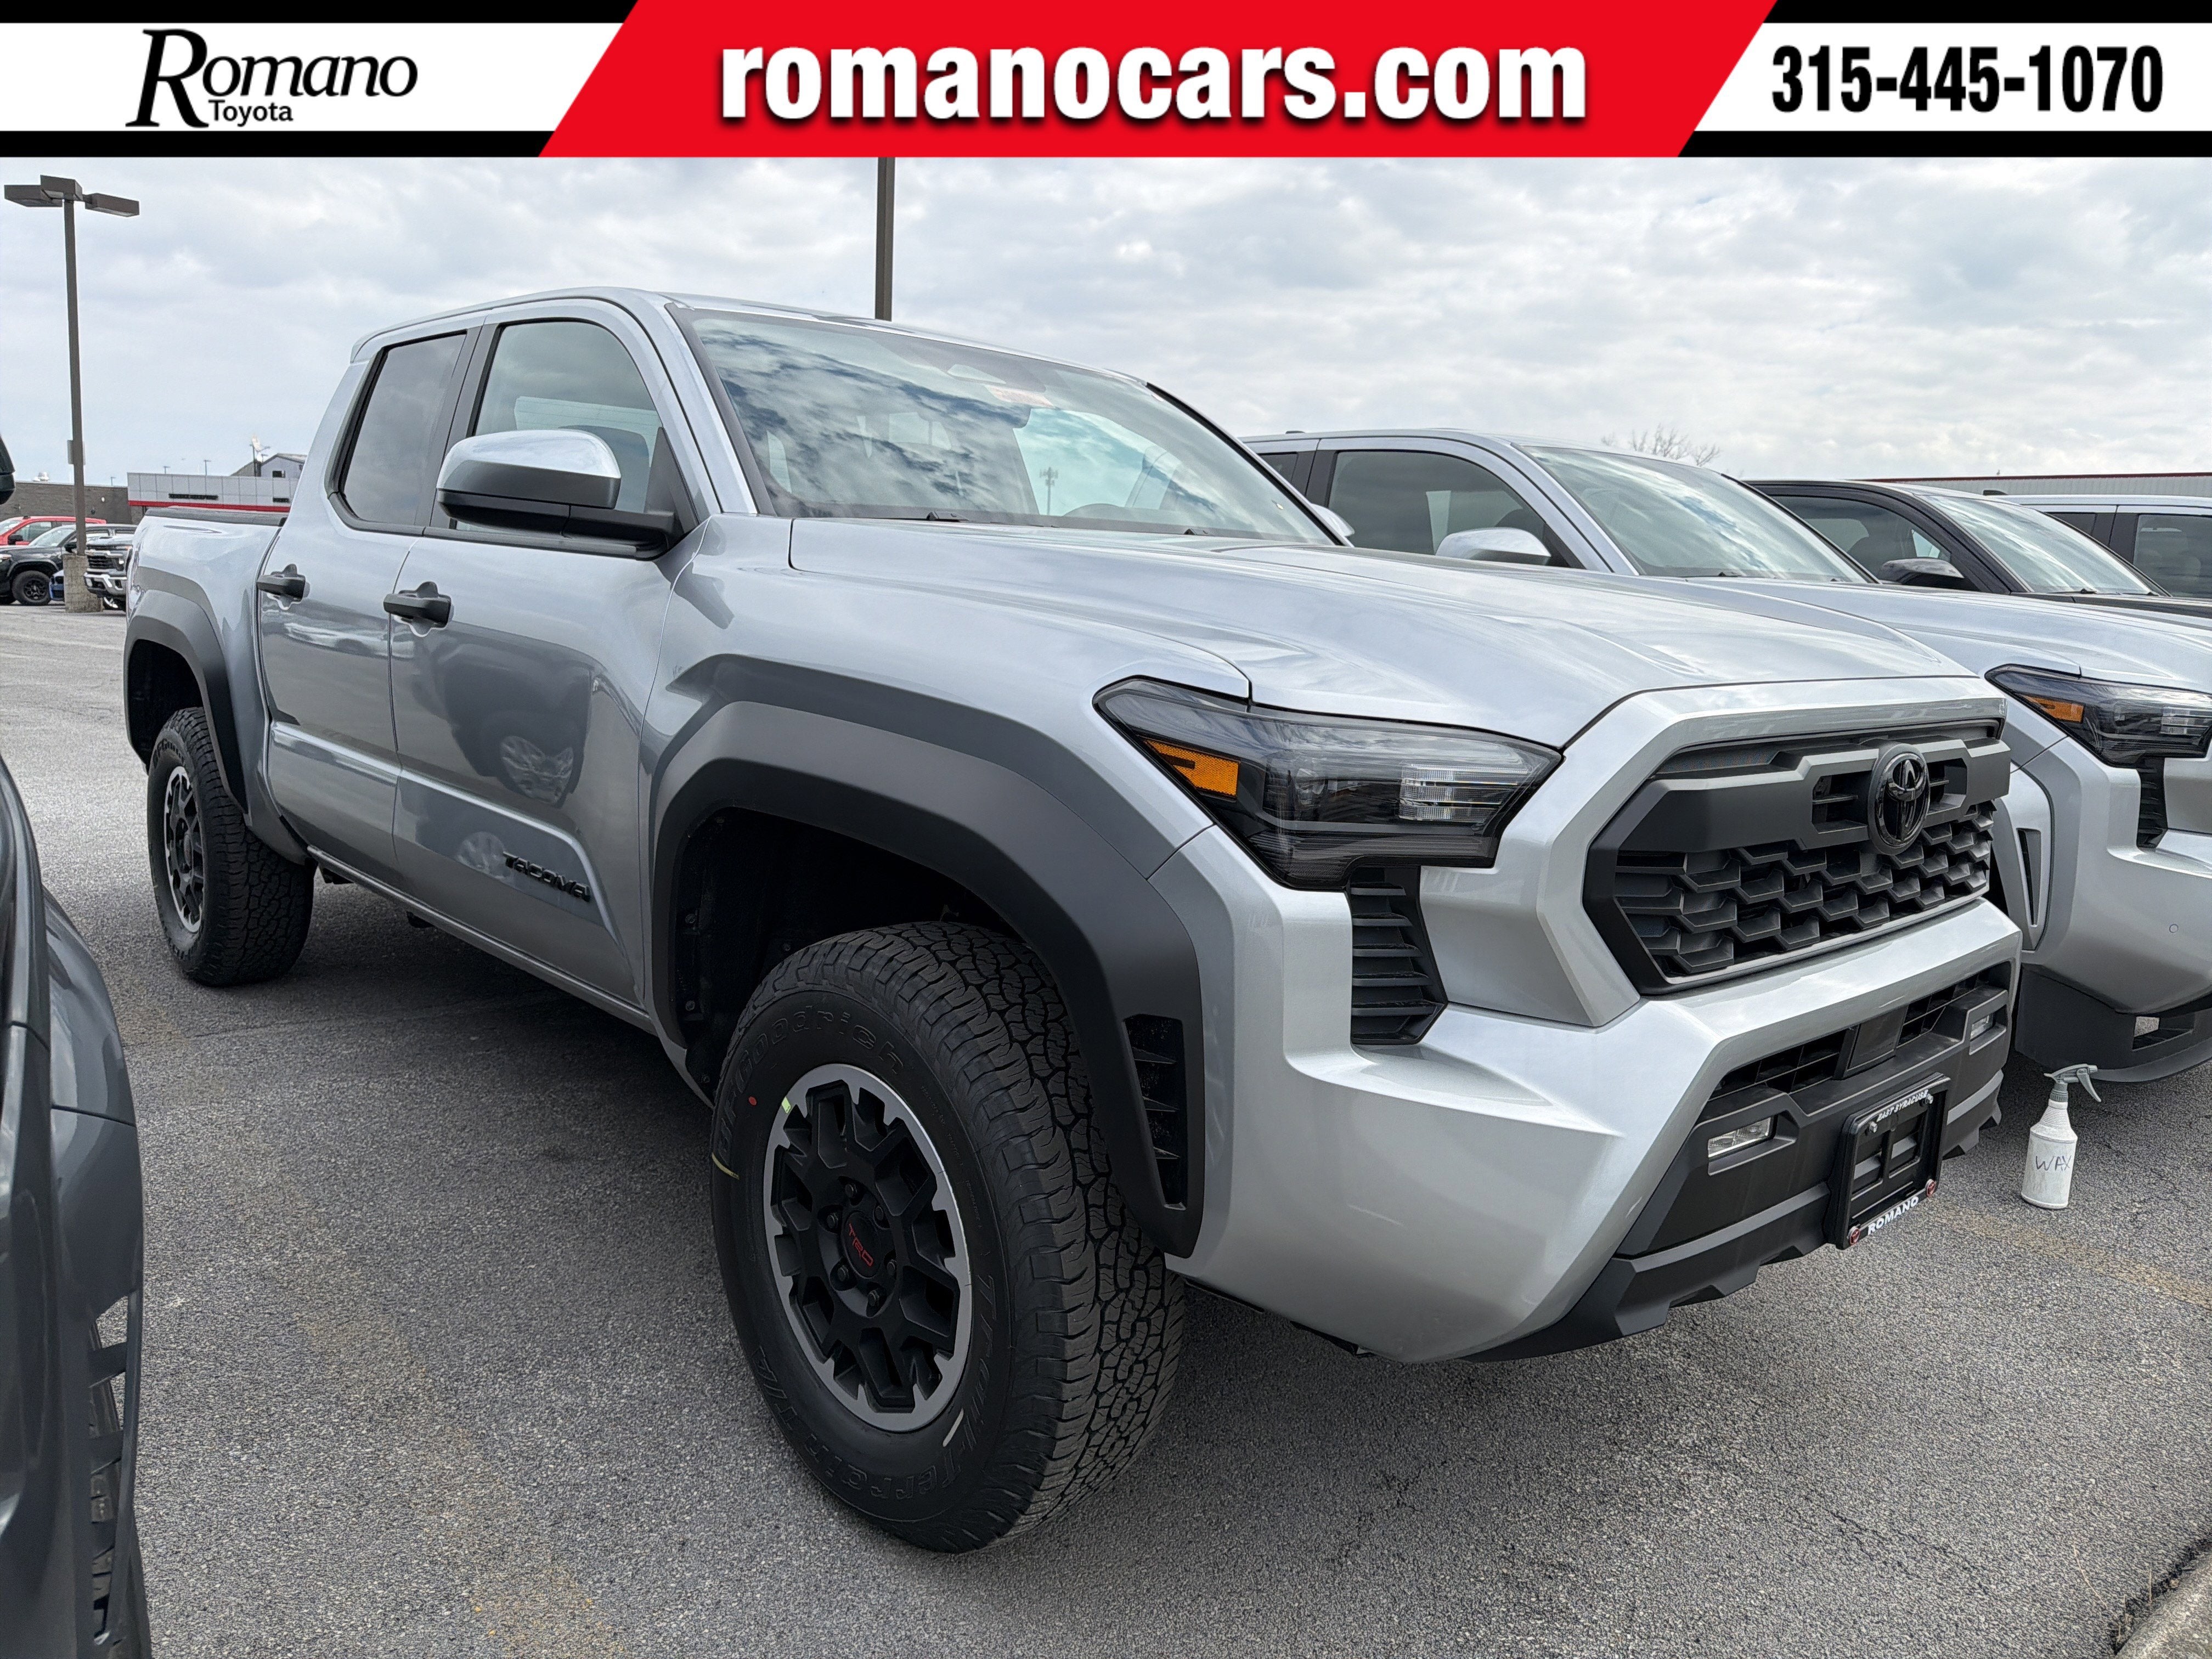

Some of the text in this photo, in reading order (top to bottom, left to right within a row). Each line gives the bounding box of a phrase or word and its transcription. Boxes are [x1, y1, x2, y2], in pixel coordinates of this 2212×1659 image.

[503, 851, 591, 902] TACOMA
[1876, 1090, 1929, 1122] EAST SYRACUSE
[2035, 1154, 2072, 1172] WAX
[1867, 1196, 1919, 1235] ROMANO
[848, 1222, 874, 1267] TRD
